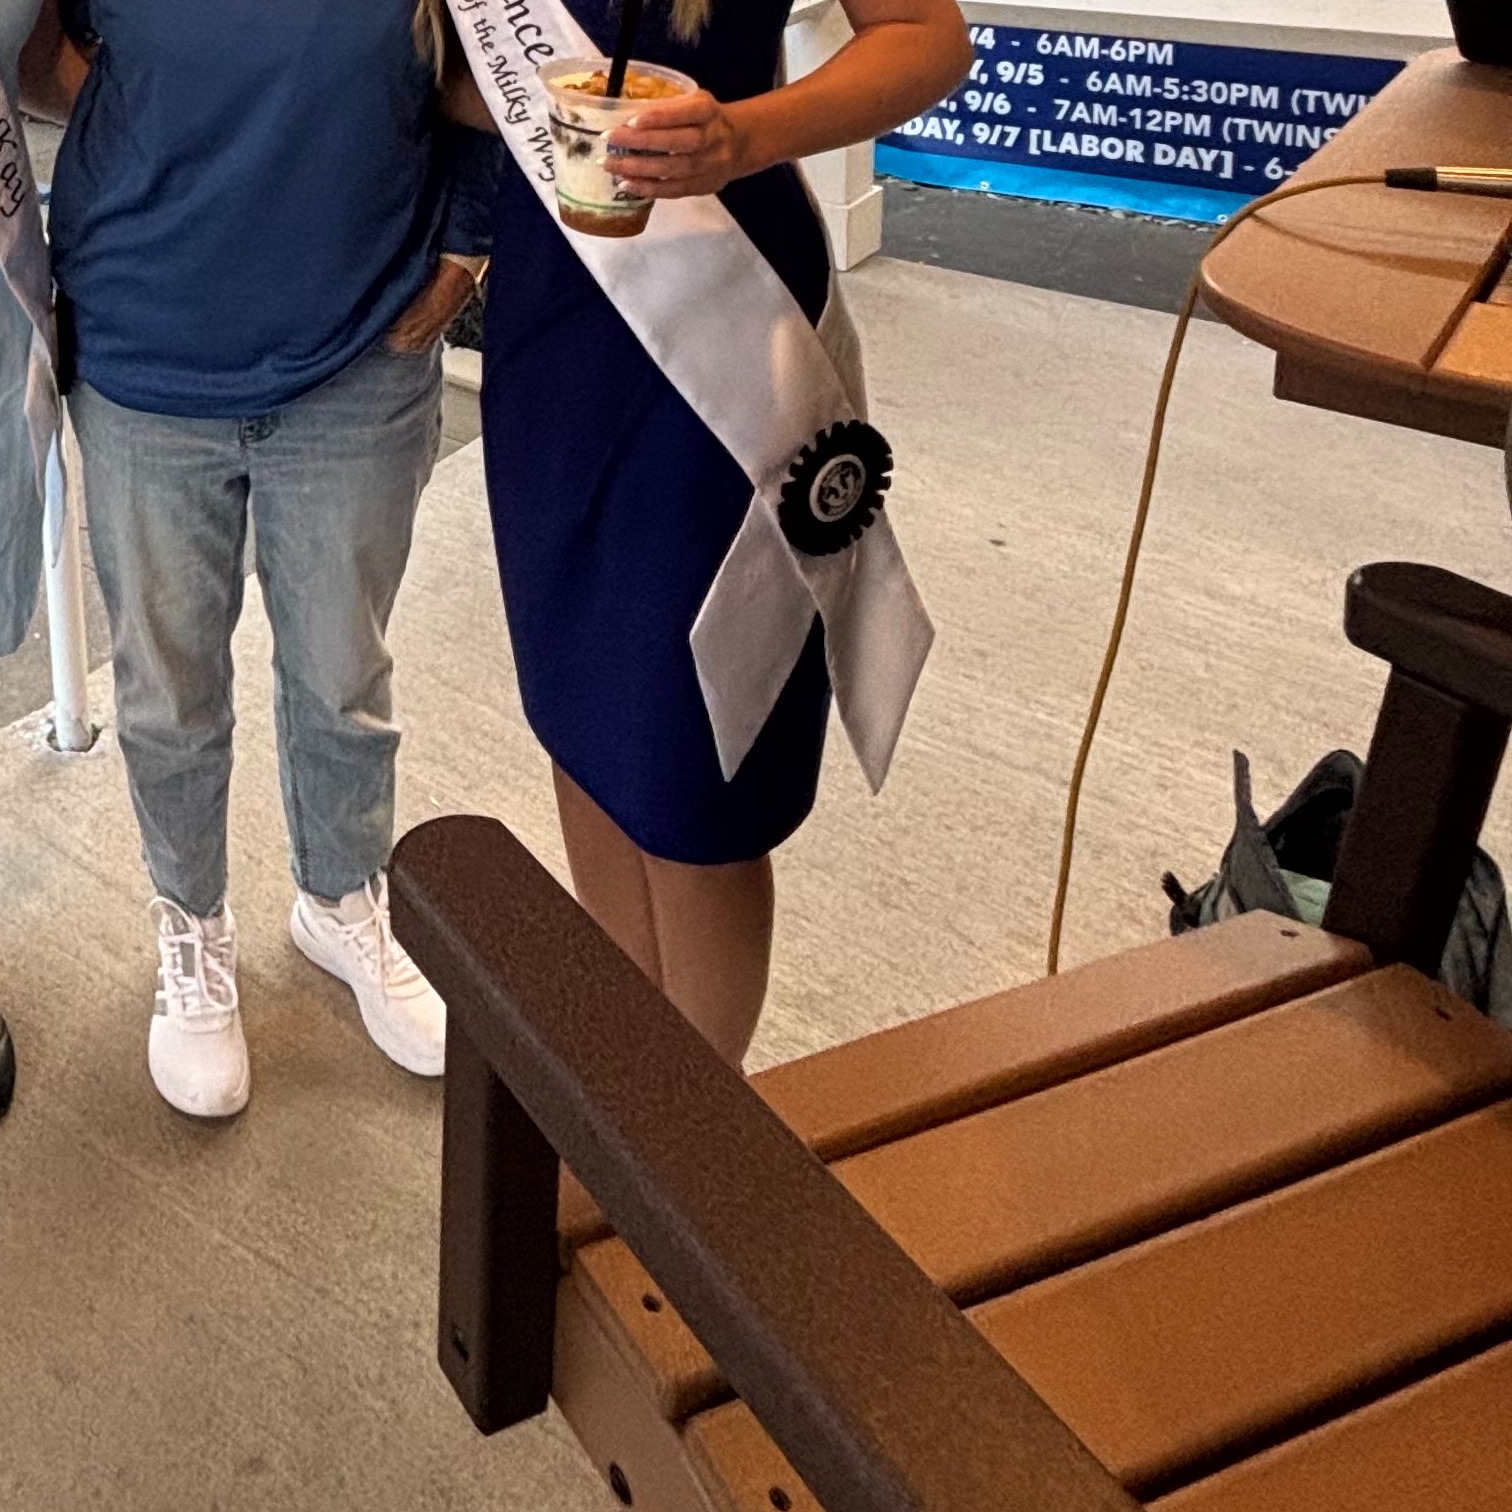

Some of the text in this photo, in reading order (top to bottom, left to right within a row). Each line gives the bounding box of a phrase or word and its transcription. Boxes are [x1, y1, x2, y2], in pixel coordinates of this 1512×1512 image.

[473, 18, 497, 54] the
[487, 55, 531, 125] Milky
[1037, 33, 1174, 66] 6AM-6PM
[996, 61, 1044, 85] 9/5
[1086, 71, 1279, 109] 6AM-5:30PM
[964, 90, 1011, 115] 9/6
[1054, 99, 1211, 137] 7AM-12PM
[972, 122, 1021, 147] 9/7
[1029, 128, 1145, 164] [LABOR
[1153, 142, 1234, 179] DAY]
